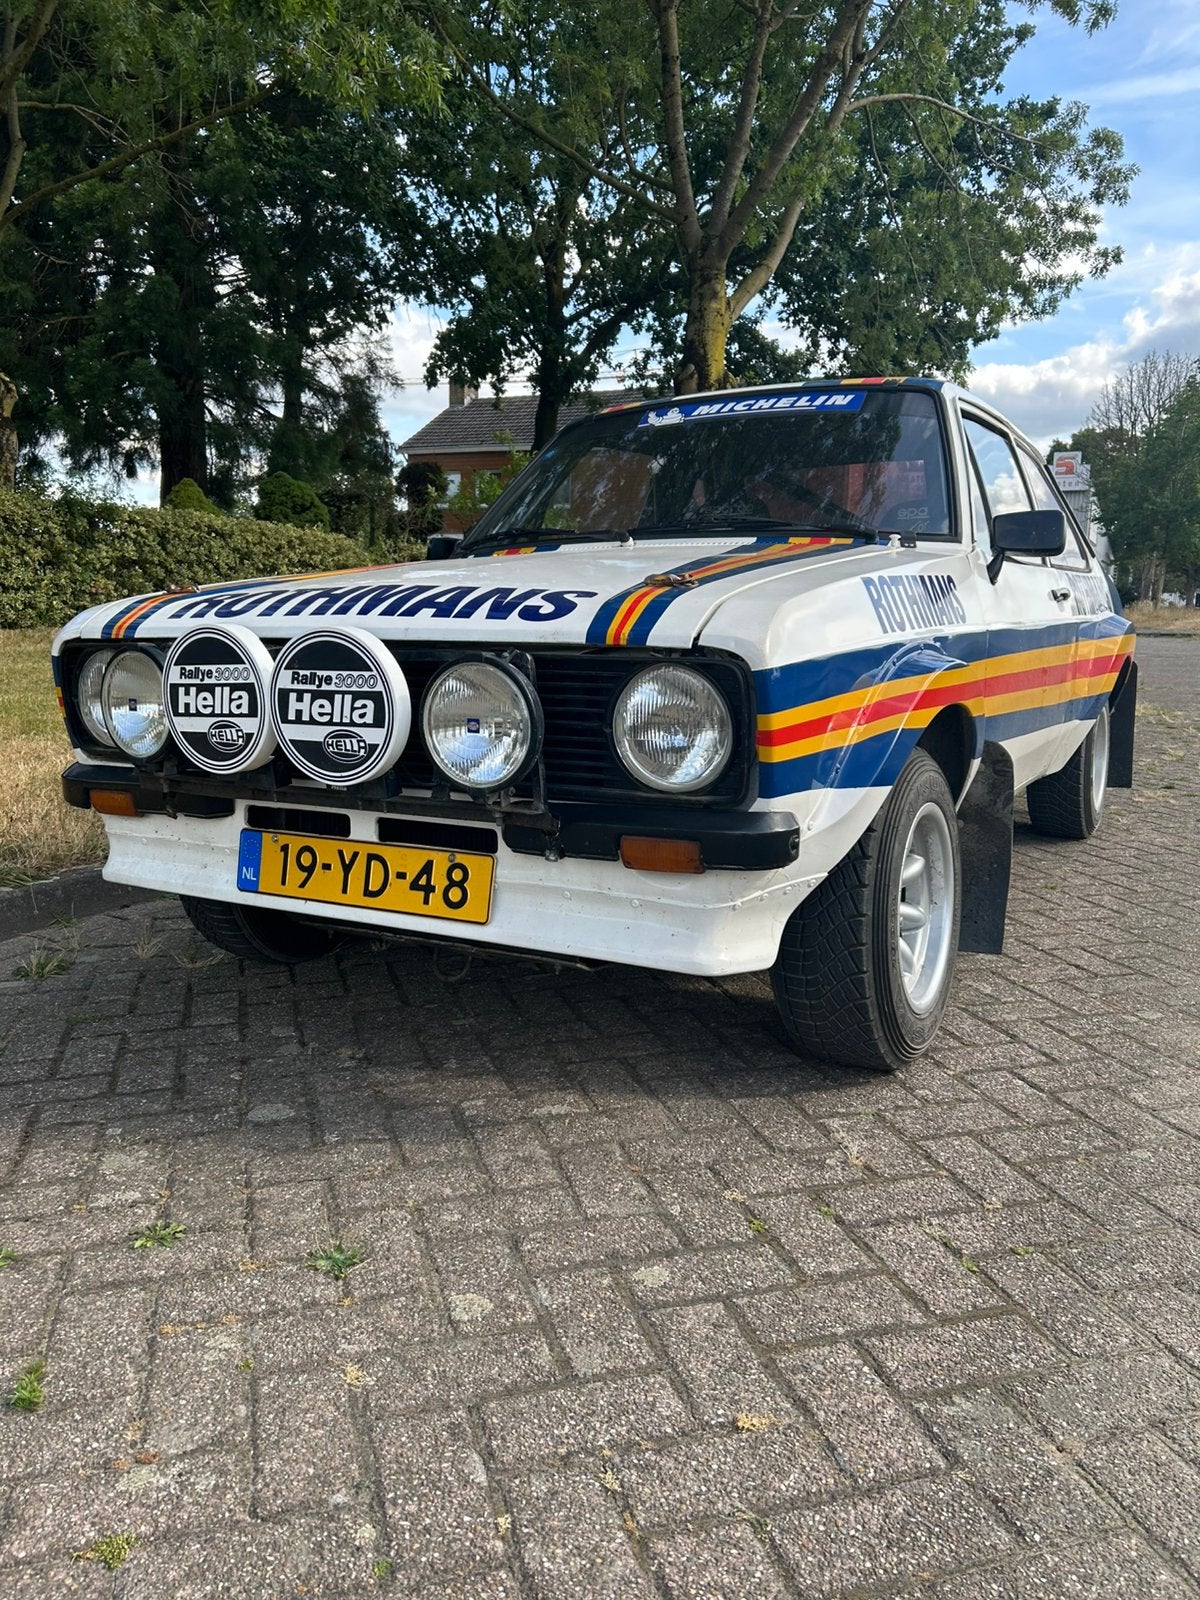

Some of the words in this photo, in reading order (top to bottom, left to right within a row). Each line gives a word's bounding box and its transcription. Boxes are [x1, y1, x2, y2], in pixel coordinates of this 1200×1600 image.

[691, 393, 856, 416] MICHELIN
[168, 584, 598, 622] ROTHMANS
[860, 574, 967, 634] ROTHMANS
[179, 666, 213, 681] Rallye
[214, 667, 250, 681] 3000
[291, 671, 333, 687] Rallye
[334, 673, 378, 689] 3000
[178, 686, 249, 715] Hella
[287, 691, 375, 724] Hella
[209, 728, 245, 744] HELLA
[325, 738, 367, 756] HELLA
[241, 866, 257, 881] NL
[279, 843, 471, 910] 19-YD-48
